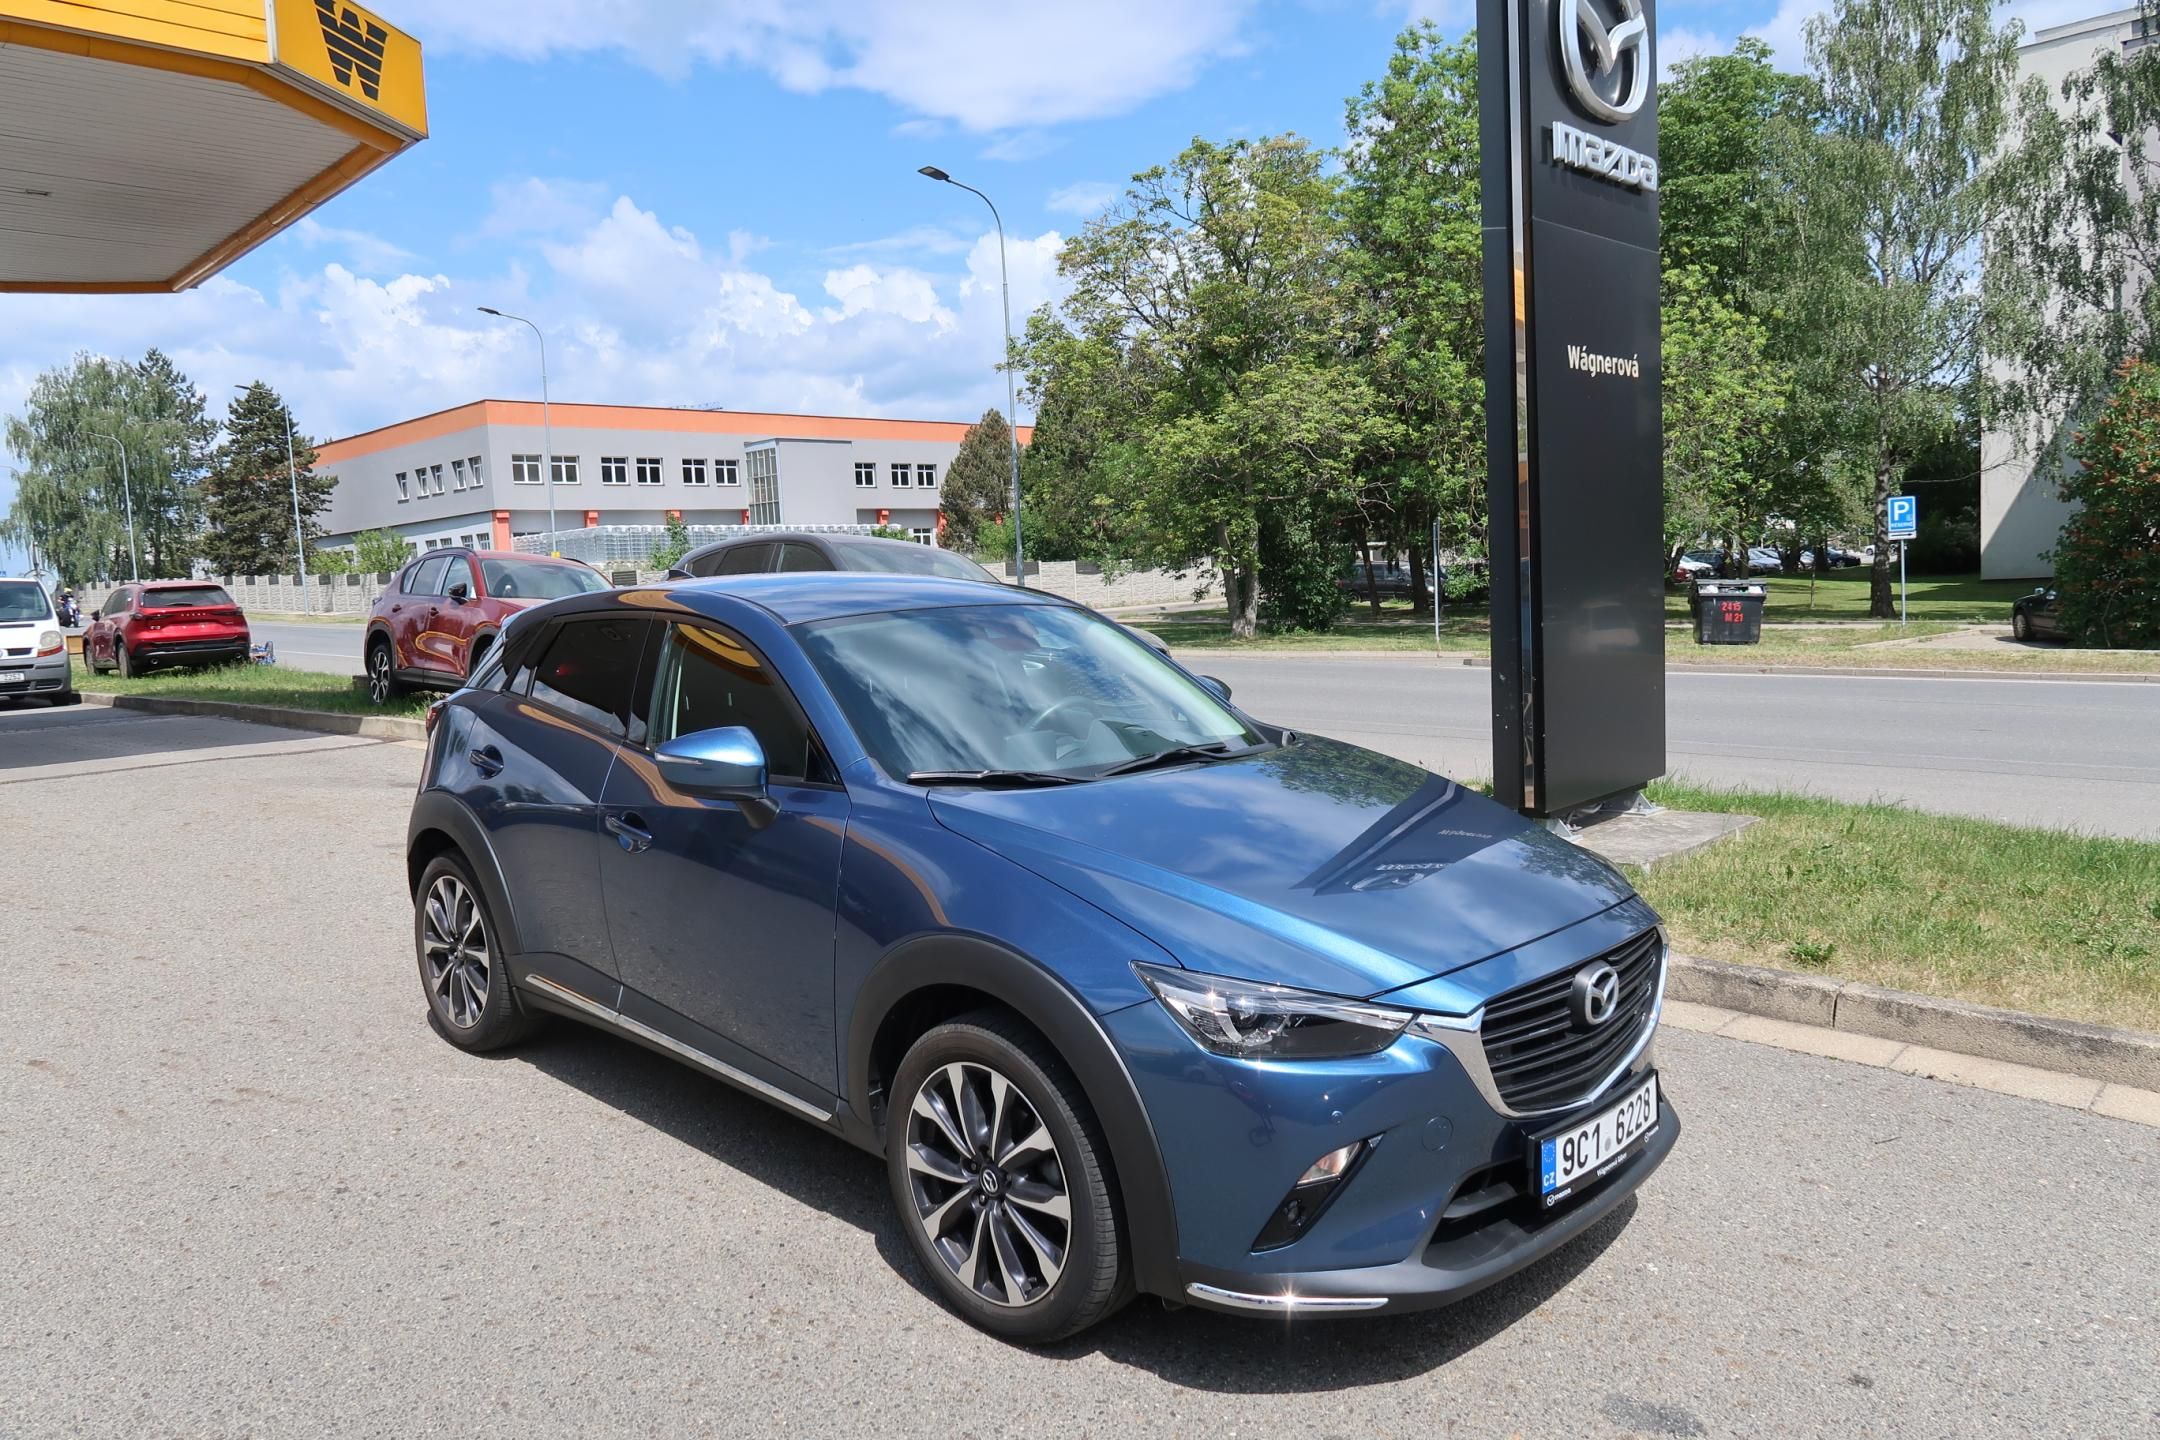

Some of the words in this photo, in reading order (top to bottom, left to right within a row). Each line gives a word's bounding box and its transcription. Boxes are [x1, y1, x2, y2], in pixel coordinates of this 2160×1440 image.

[1567, 344, 1640, 378] Wágnerová
[1893, 501, 1910, 521] P
[1720, 601, 1743, 612] 2415
[1733, 612, 1745, 622] 21
[1562, 1122, 1601, 1177] 9C1
[1615, 1086, 1651, 1145] 6228
[1543, 1171, 1556, 1187] CZ
